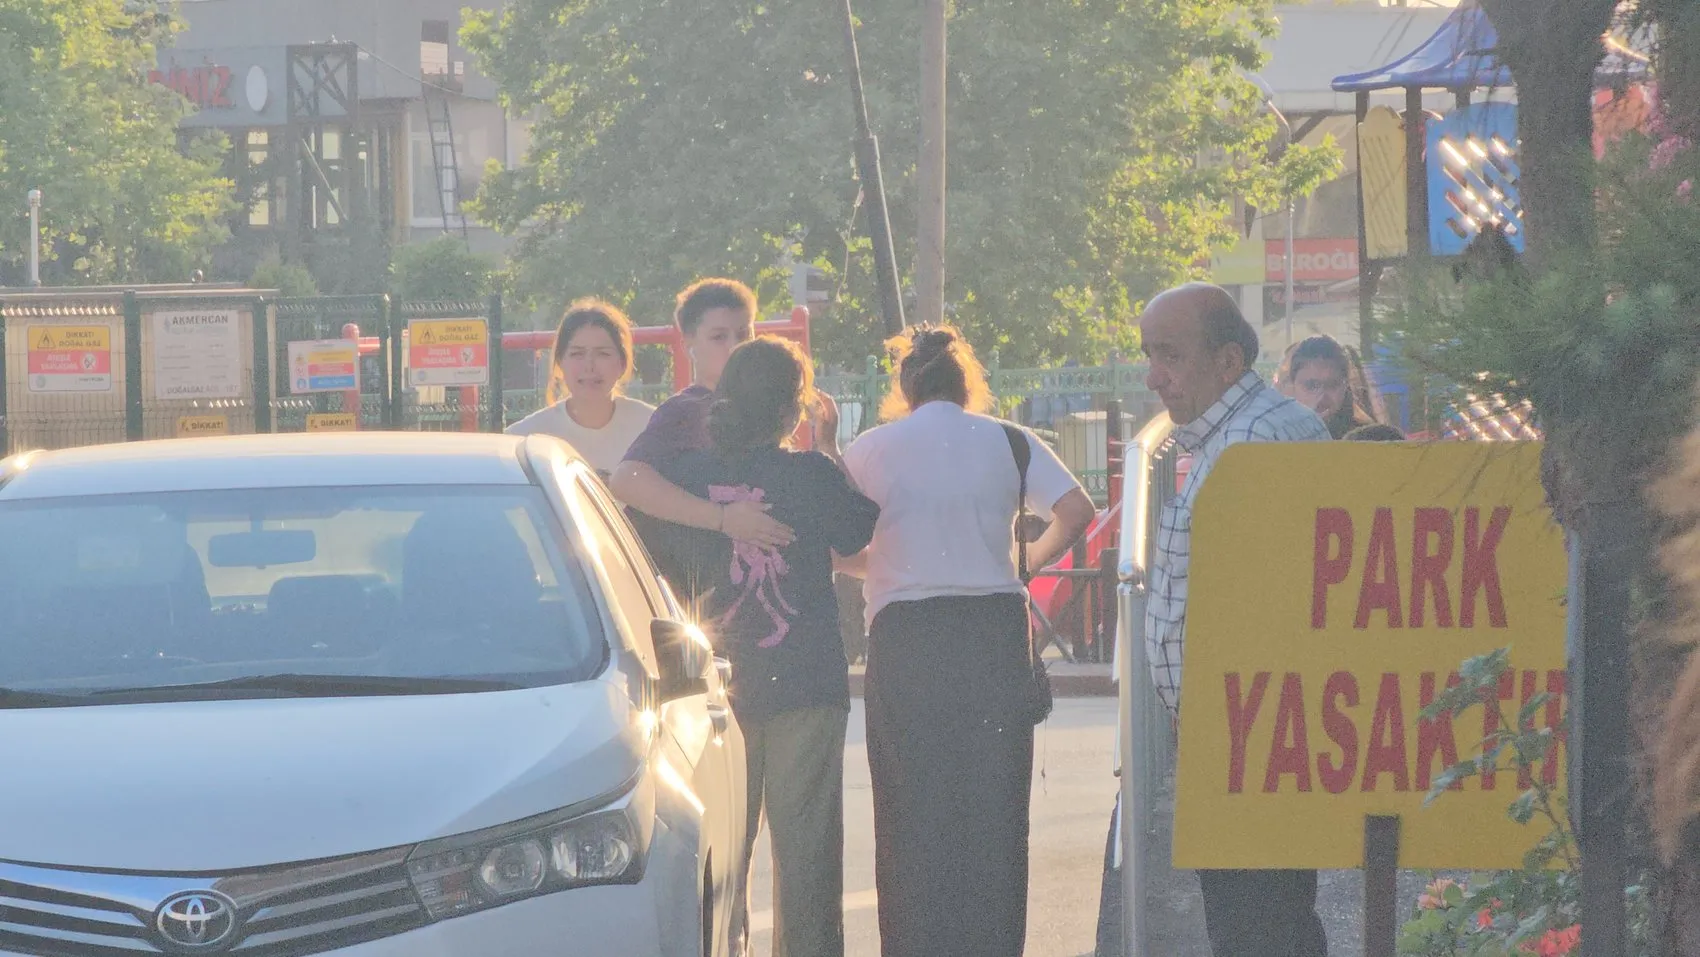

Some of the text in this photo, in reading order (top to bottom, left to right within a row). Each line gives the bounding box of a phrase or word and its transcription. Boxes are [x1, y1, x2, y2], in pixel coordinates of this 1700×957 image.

[172, 314, 229, 325] AKMERCAN
[191, 420, 224, 430] DİKKAT!
[320, 417, 353, 427] DİKKAT!
[1310, 506, 1513, 631] PARK
